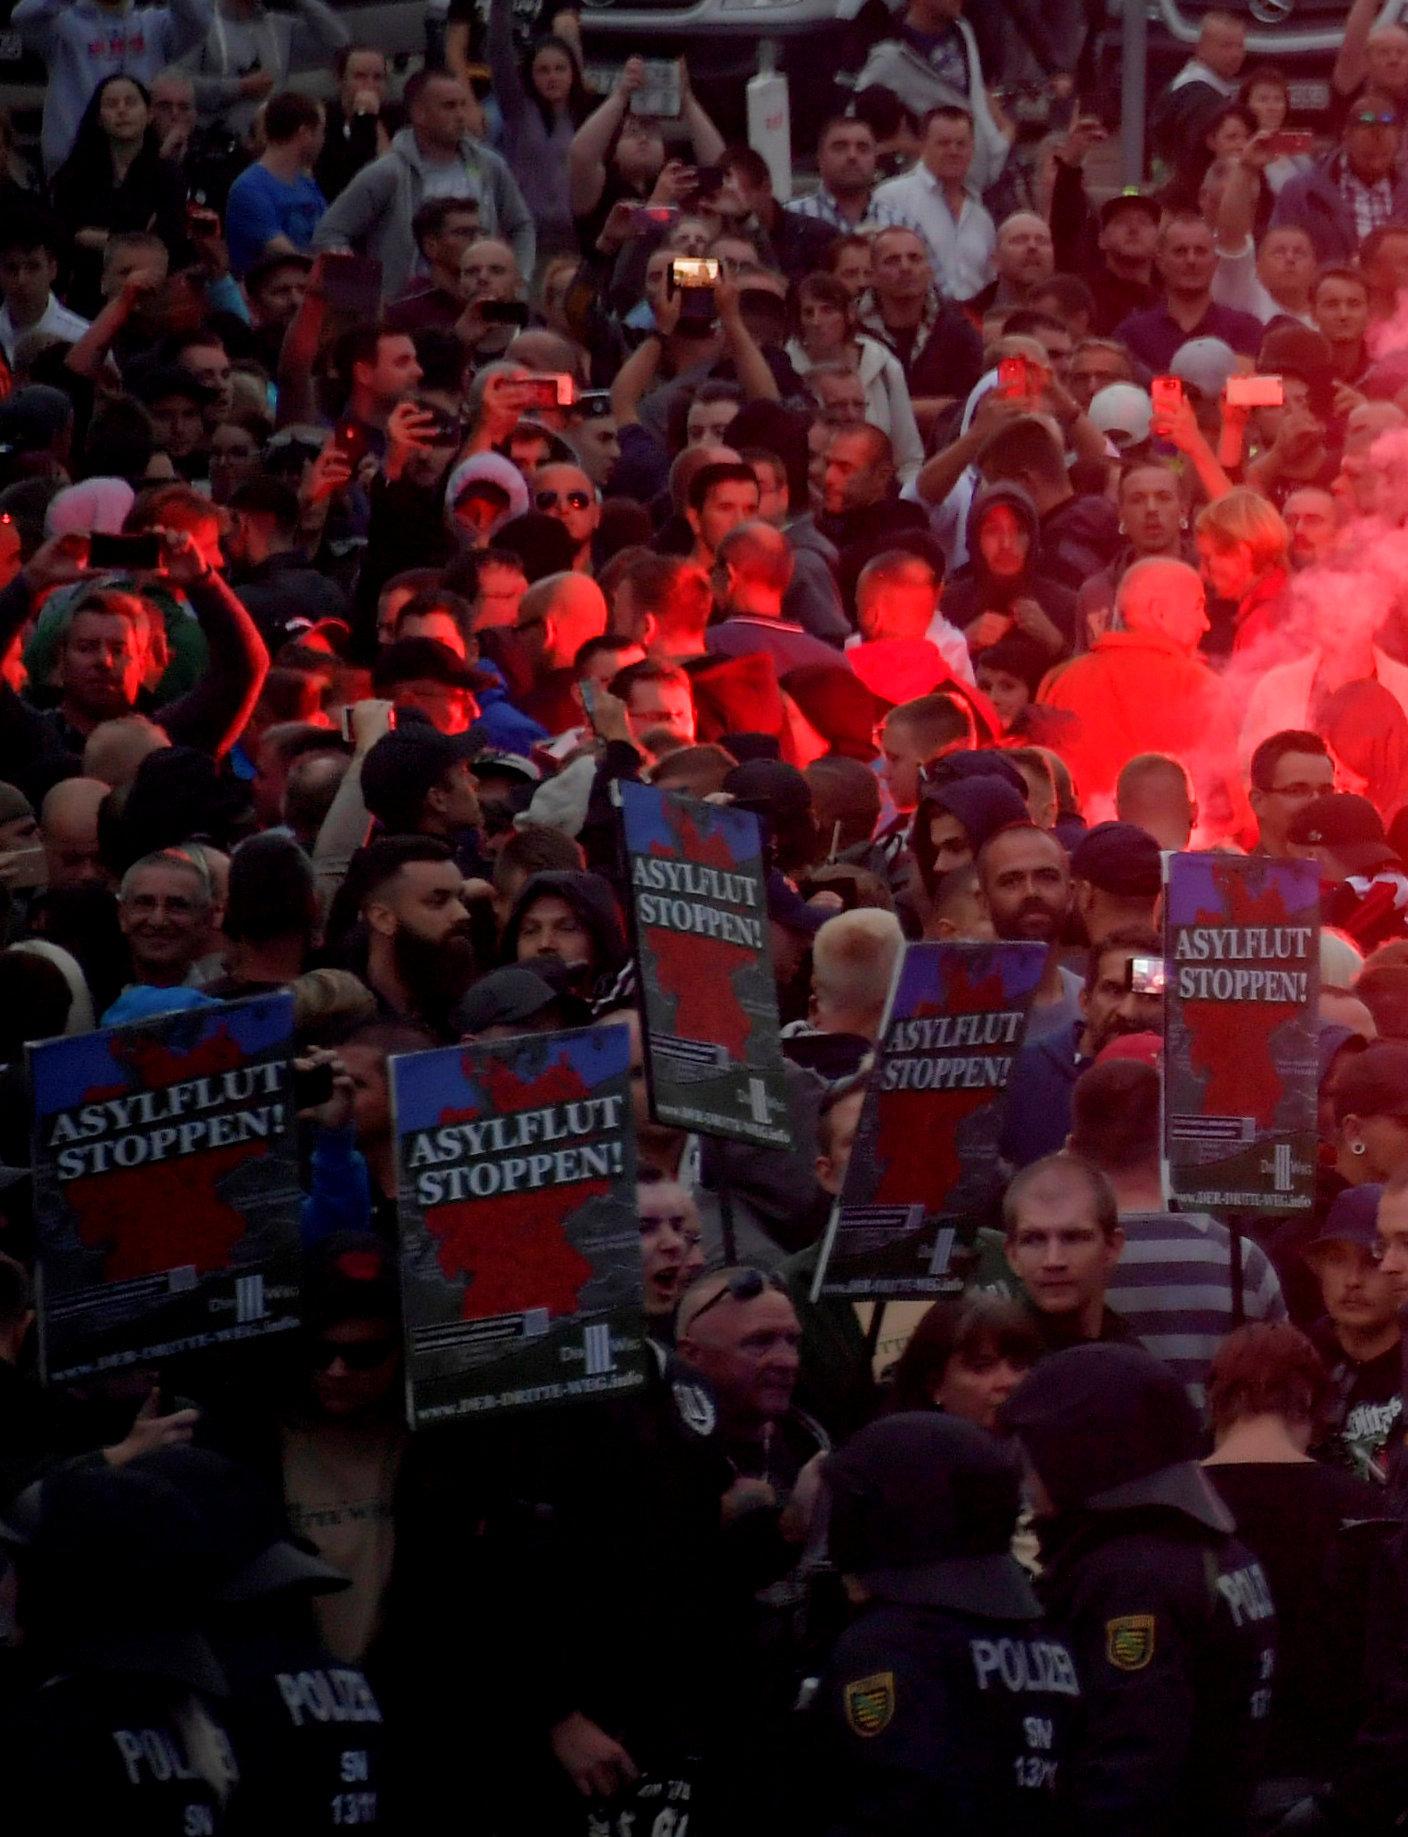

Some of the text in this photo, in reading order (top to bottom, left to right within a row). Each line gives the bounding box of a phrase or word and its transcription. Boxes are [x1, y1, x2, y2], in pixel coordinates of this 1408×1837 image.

[632, 857, 758, 907] ASYLFLUT
[638, 892, 763, 949] STOPPEN!
[1174, 927, 1312, 960] ASYLFLUT
[1179, 966, 1308, 1003] STOPPEN!
[884, 1011, 1024, 1053] ASYLFLUT
[880, 1056, 1013, 1091] STOPPEN!
[48, 1060, 288, 1147] ASYLFLUT
[56, 1103, 286, 1181] STOPPEN!
[408, 1095, 623, 1168] ASYLFLUT
[417, 1142, 624, 1205] STOPPEN!
